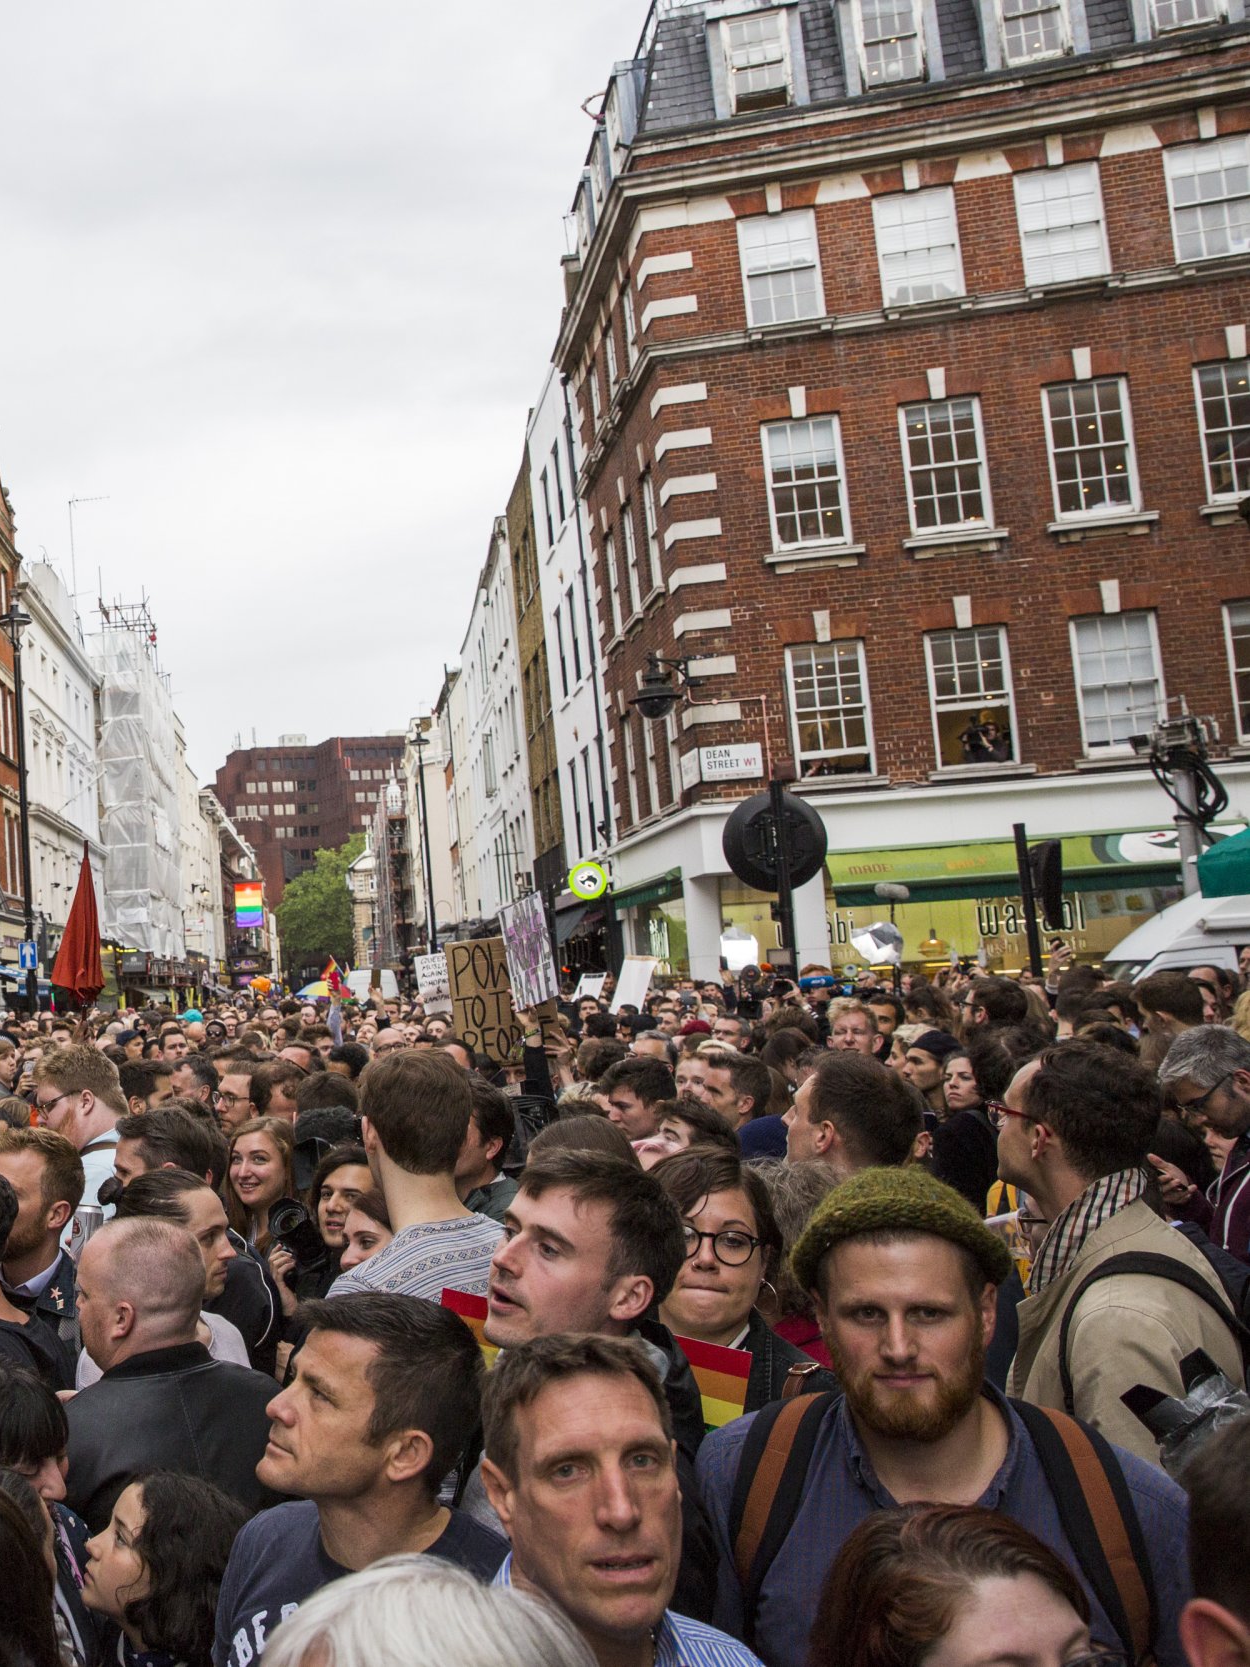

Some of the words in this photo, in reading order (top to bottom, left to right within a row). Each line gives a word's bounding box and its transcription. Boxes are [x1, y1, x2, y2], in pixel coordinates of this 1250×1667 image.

[706, 749, 730, 760] DEAN
[707, 759, 740, 770] STREET
[743, 757, 757, 767] W1
[455, 994, 486, 1029] TO
